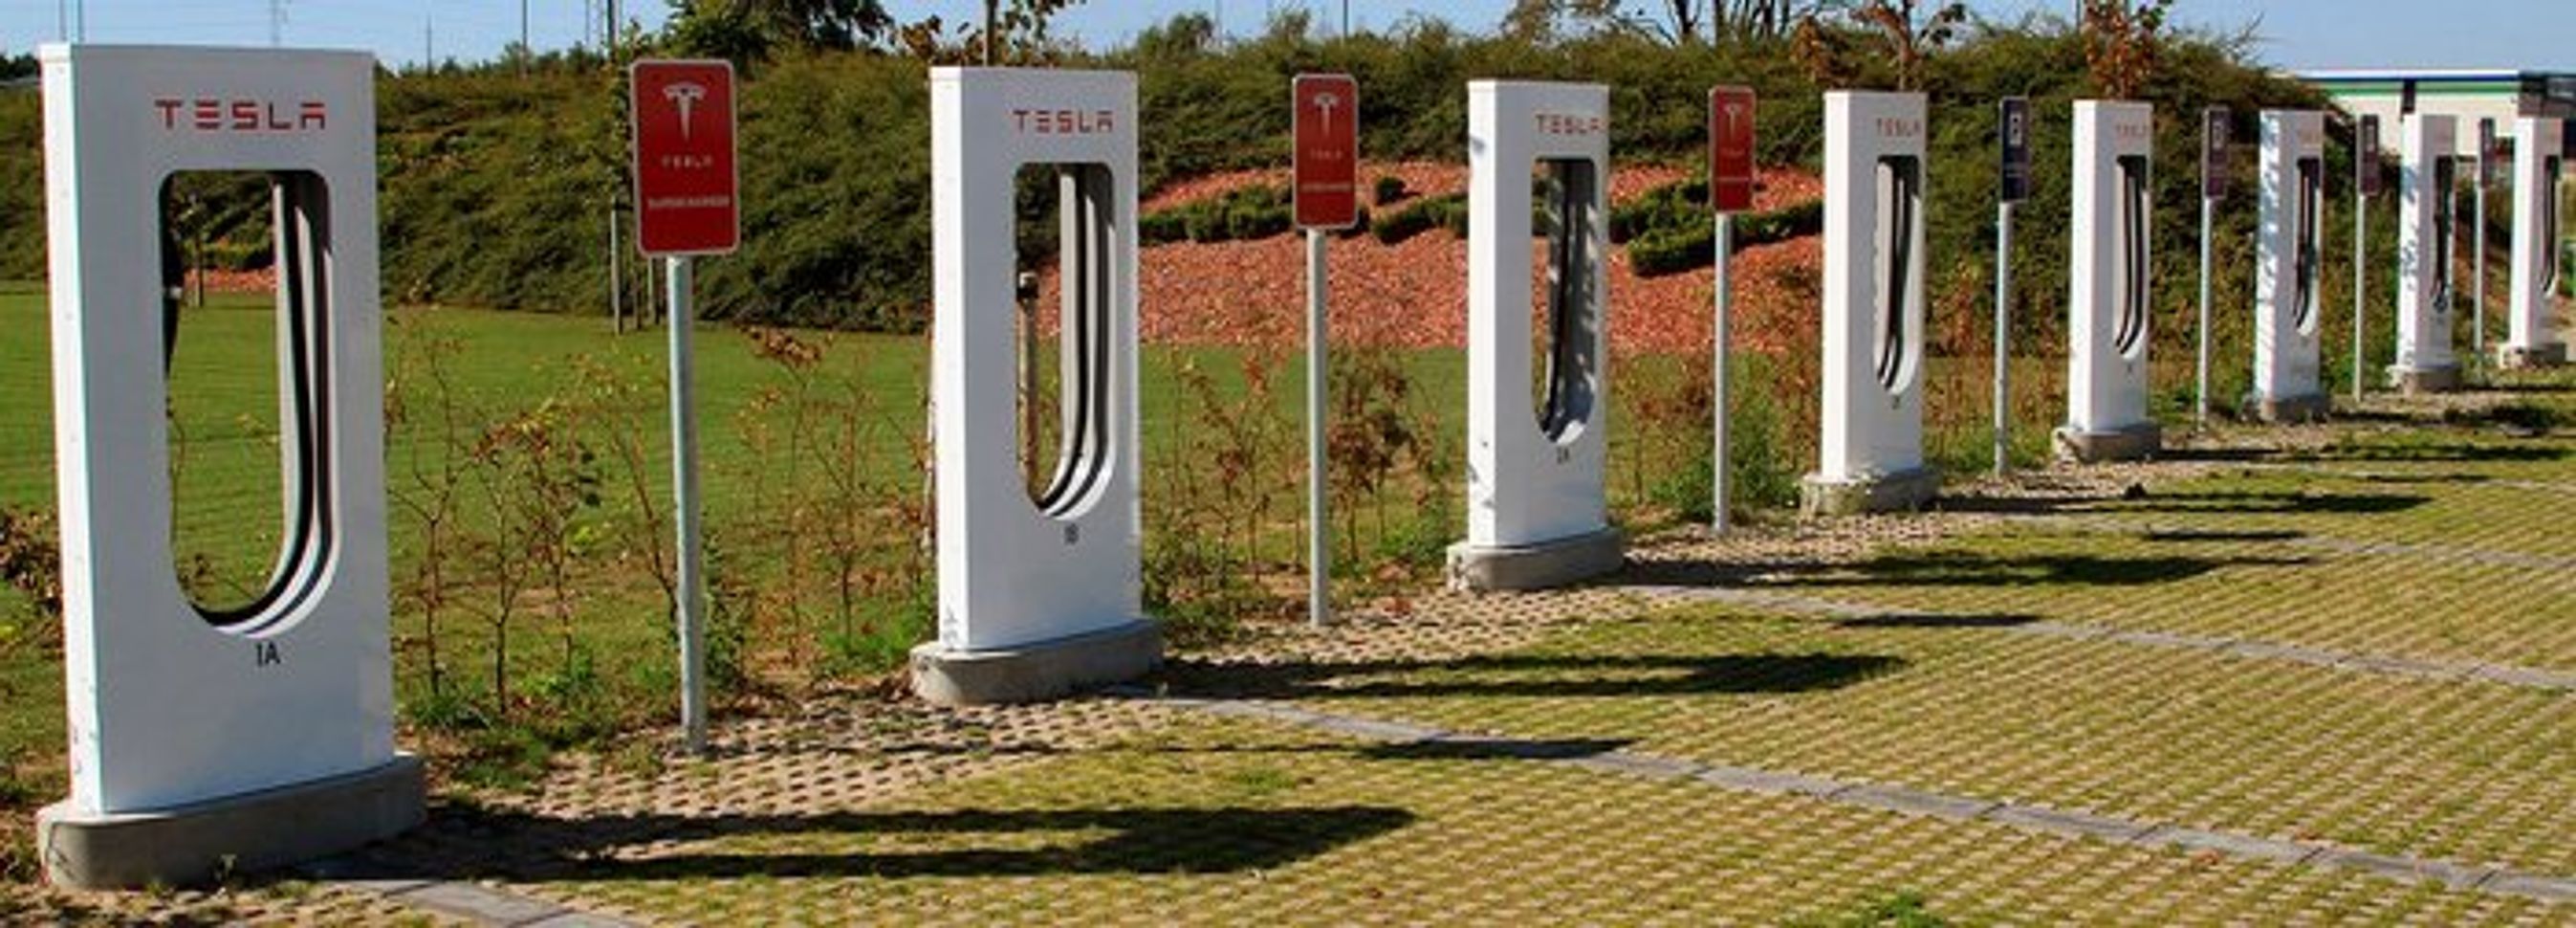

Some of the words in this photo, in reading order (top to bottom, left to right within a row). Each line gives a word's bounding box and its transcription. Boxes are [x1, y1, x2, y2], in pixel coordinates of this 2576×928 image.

[155, 99, 325, 130] TESLA
[1013, 109, 1113, 134] TESLA
[1535, 114, 1606, 135] TESLA
[256, 641, 281, 668] 1A
